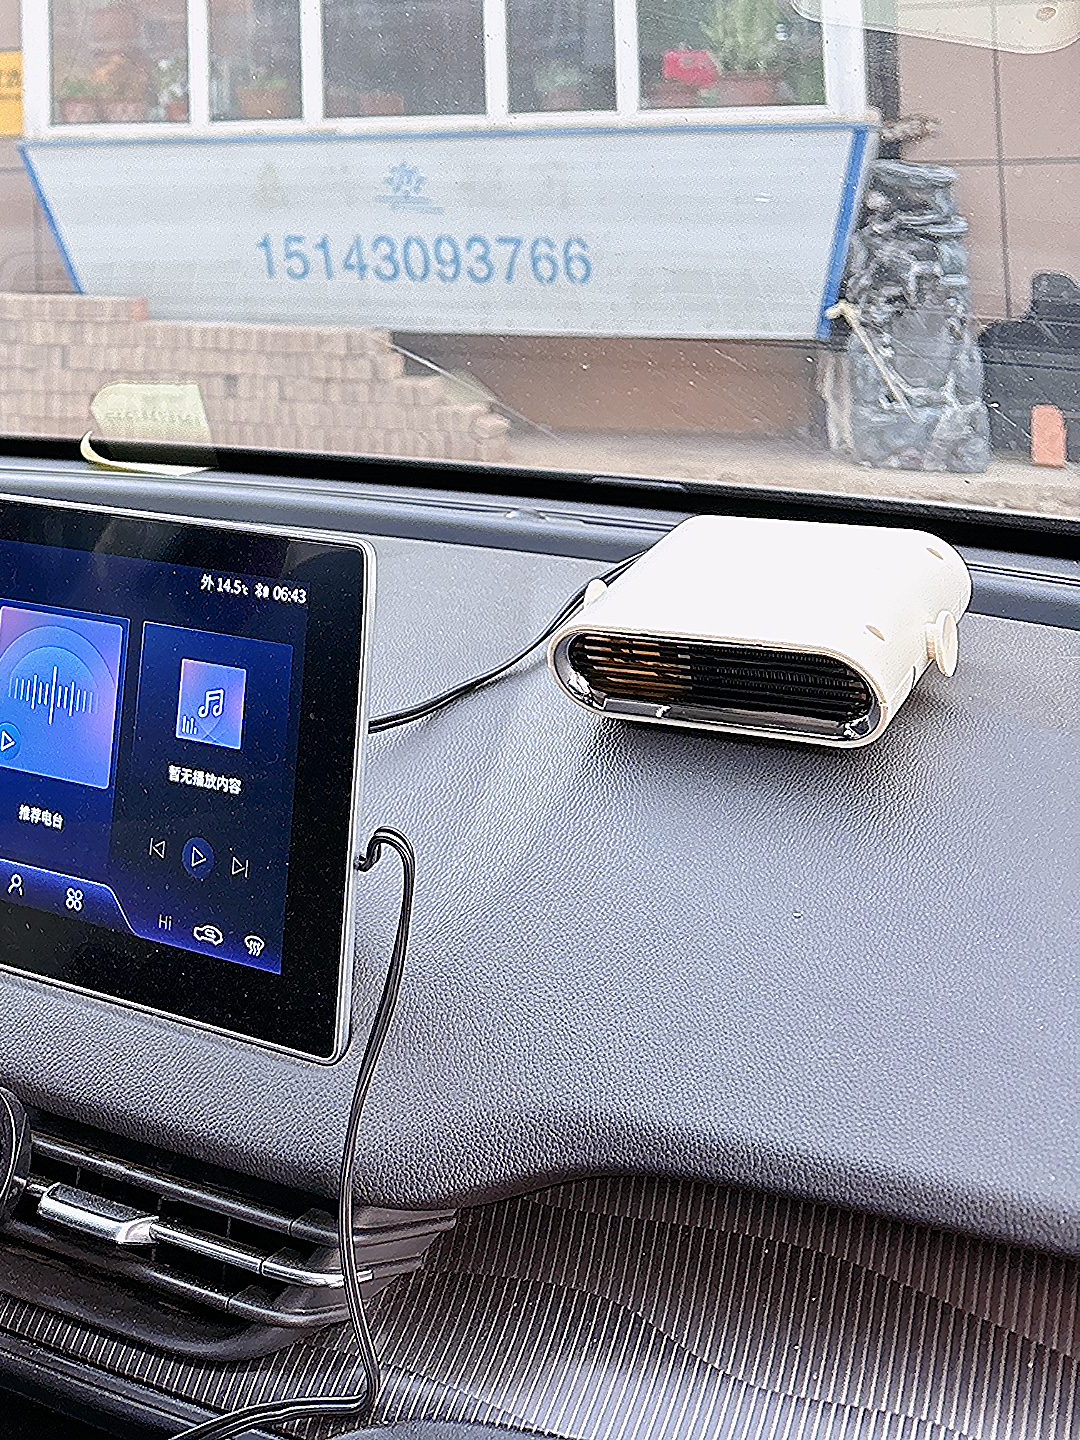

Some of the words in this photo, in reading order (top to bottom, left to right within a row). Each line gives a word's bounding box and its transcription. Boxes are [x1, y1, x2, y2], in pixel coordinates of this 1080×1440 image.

[256, 233, 594, 285] 15143093766
[272, 585, 307, 604] 06:43
[168, 764, 242, 795] 暂无播放内容
[18, 803, 64, 831] 推荐电台
[159, 914, 173, 932] Hi
